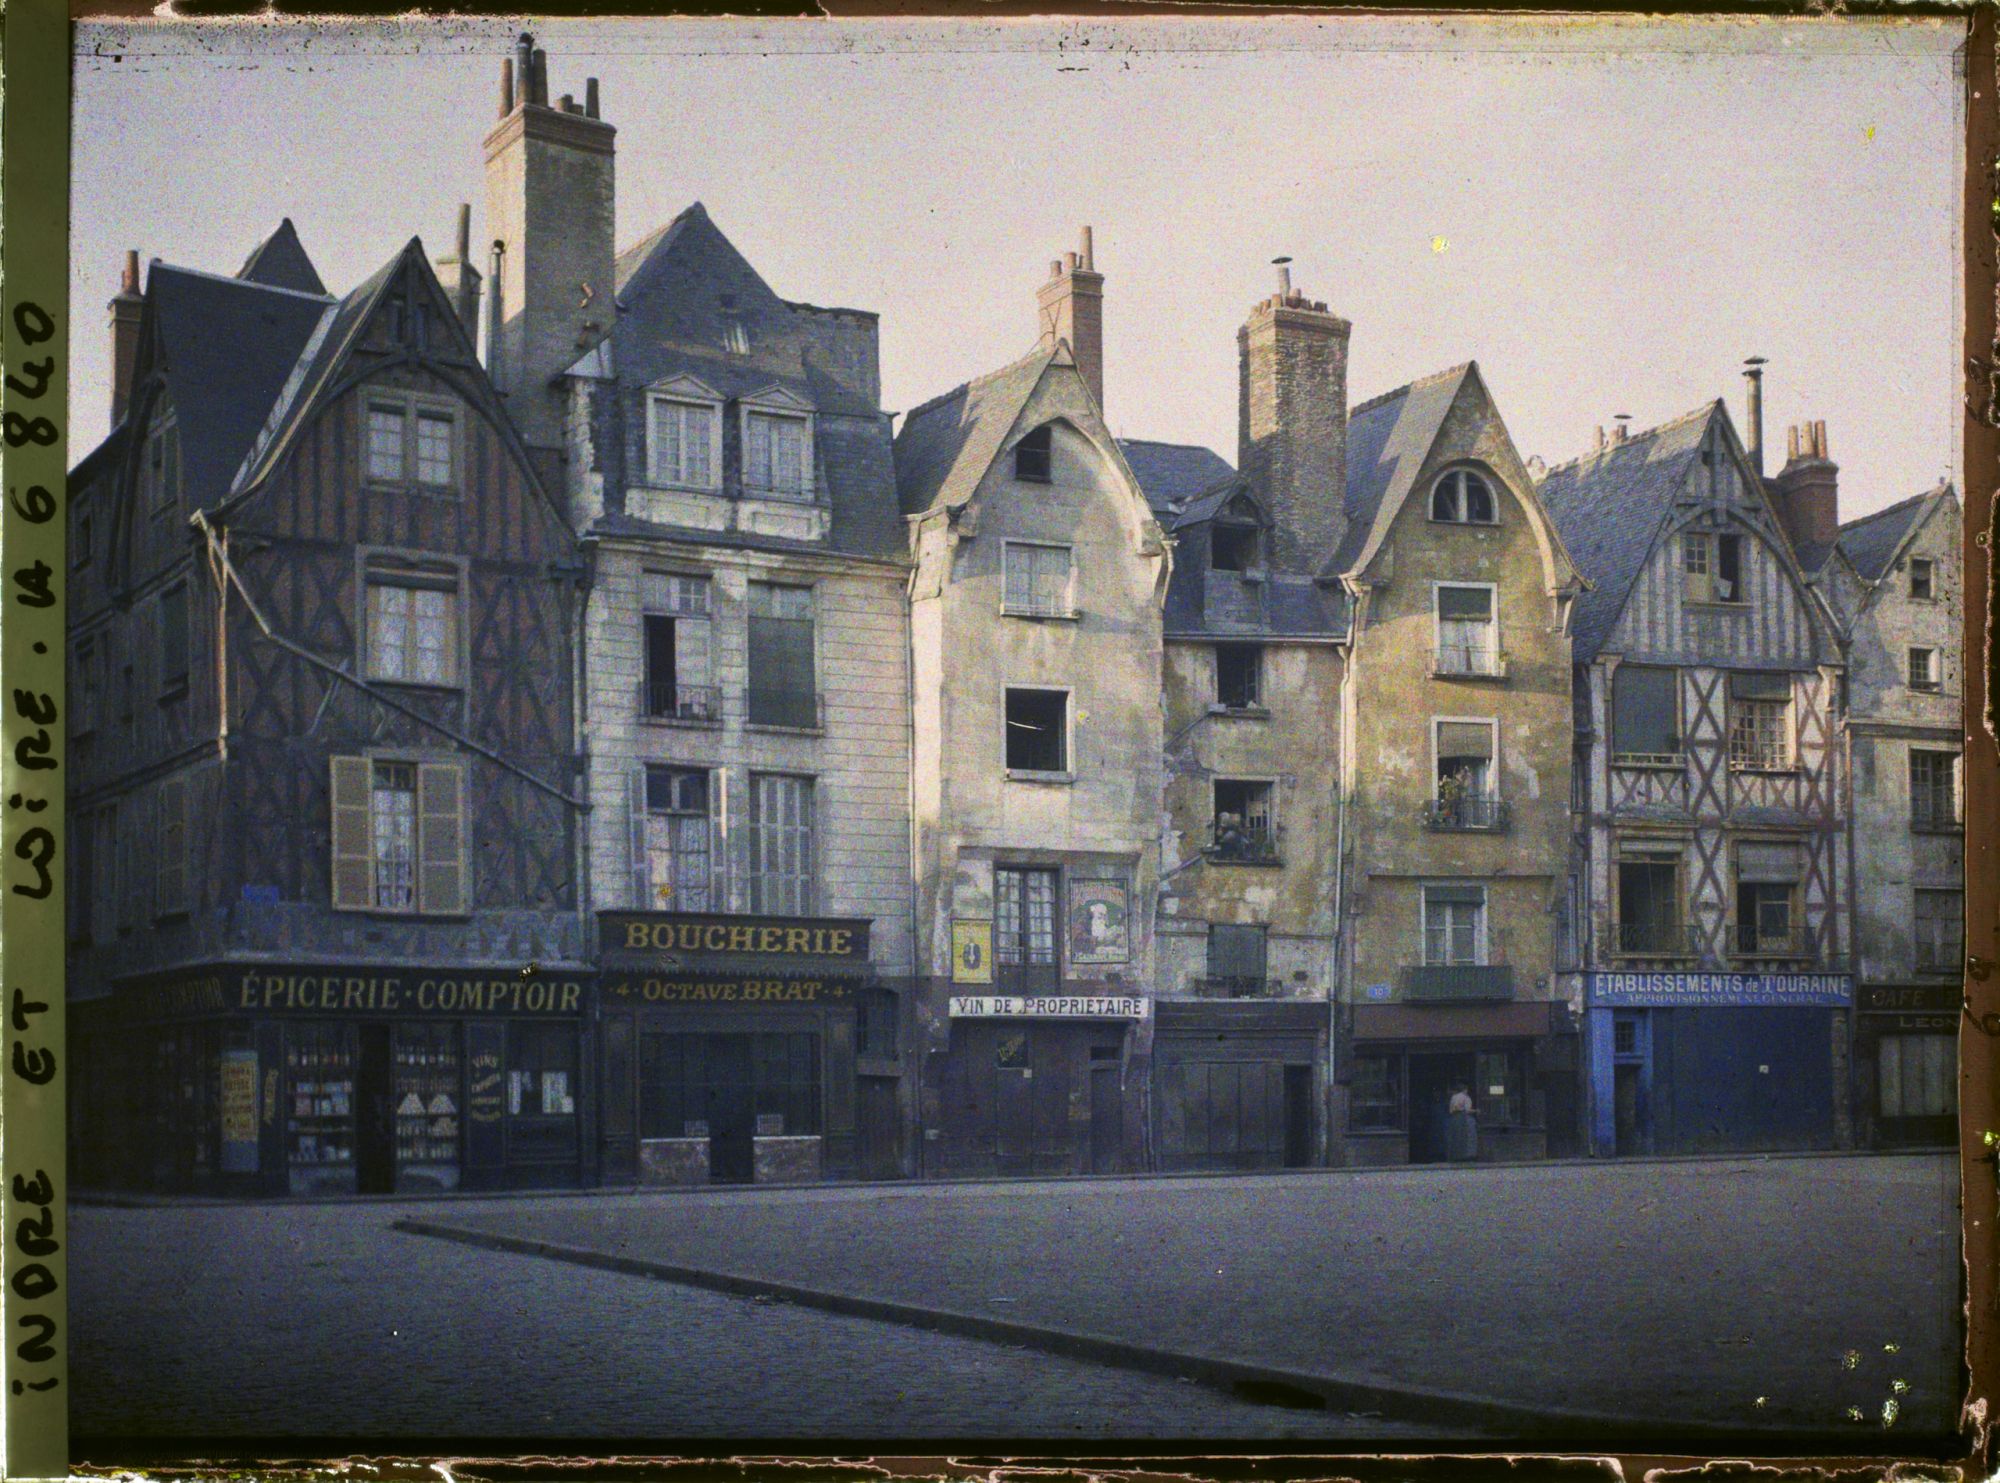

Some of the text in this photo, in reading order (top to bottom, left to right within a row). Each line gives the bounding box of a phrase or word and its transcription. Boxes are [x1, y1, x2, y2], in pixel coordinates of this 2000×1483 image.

[624, 921, 852, 955] BOUCHERIE
[418, 978, 581, 1012] COMPTOIR
[643, 979, 737, 1001] OCTAVE
[742, 980, 822, 1001] BRAT
[1594, 973, 1851, 998] ETABLISSEMENTS de TOURAINE
[957, 997, 1142, 1015] VIN DE PROPRIETAIRE
[11, 988, 57, 1086] ET
